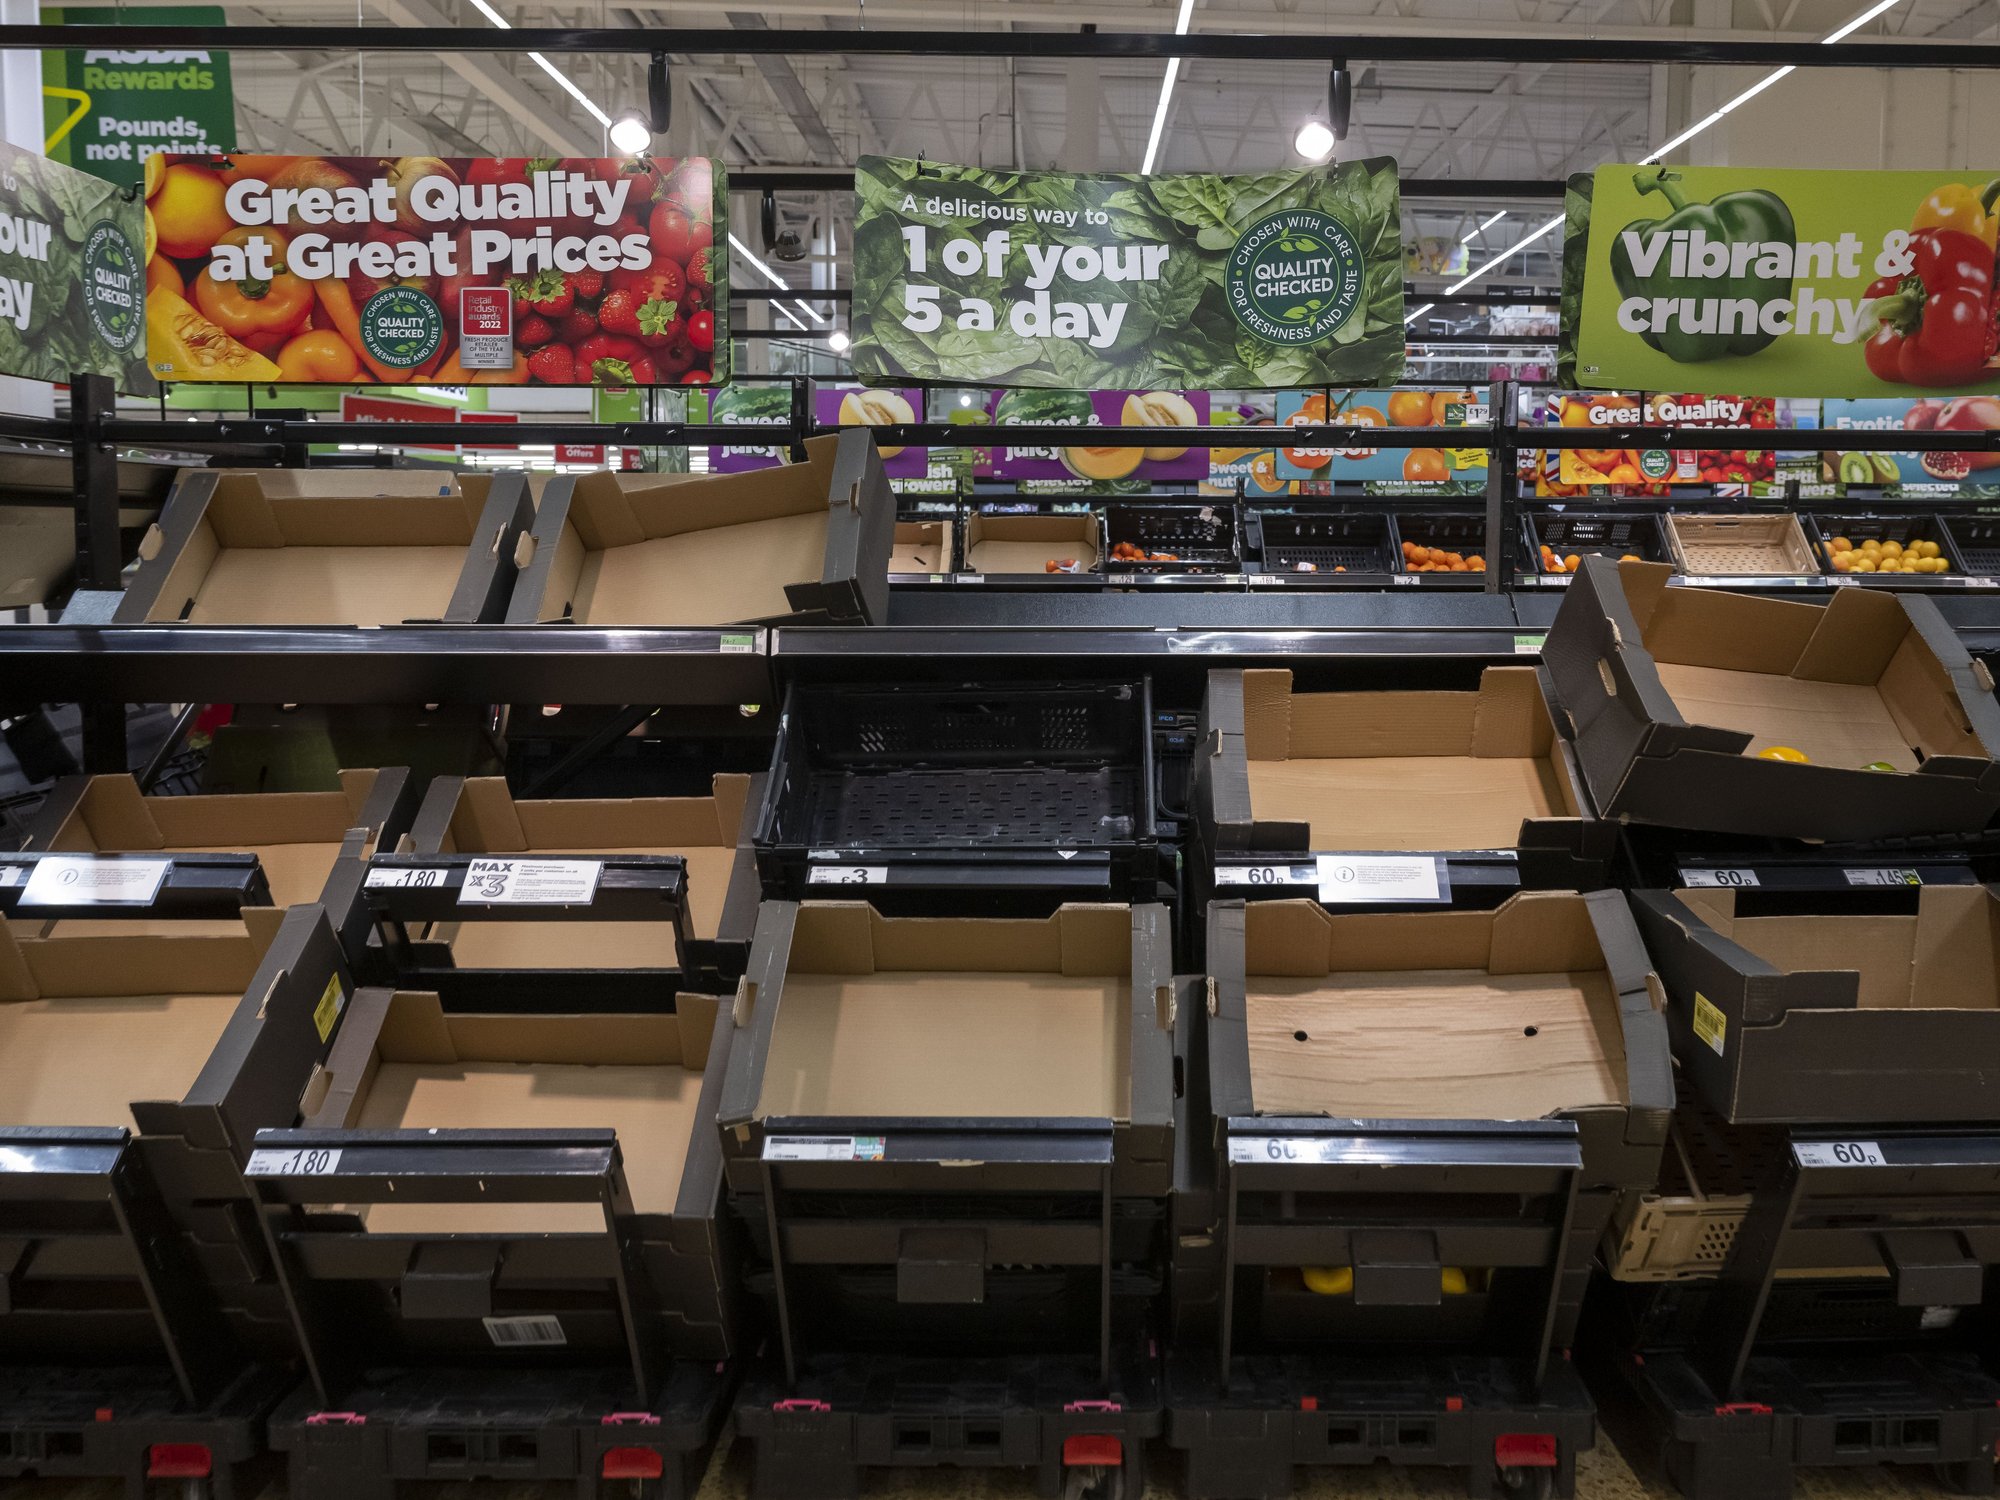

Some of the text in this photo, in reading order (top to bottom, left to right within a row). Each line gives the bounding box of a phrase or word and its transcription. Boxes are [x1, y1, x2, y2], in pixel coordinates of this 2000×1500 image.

[84, 66, 214, 90] Rewards
[98, 116, 207, 140] Pounds,
[86, 140, 222, 164] not points
[225, 171, 632, 227] Great Quality
[901, 195, 1108, 228] A delicious way to
[1237, 216, 1352, 266] CHOSEN WITH CARE
[209, 227, 652, 282] at Great Prices
[902, 227, 1169, 290] 1 of your
[1622, 230, 1916, 279] Vibrant &
[95, 267, 131, 290] QUALITY
[1254, 258, 1334, 280] QUALITY
[96, 286, 132, 308] CHECKED
[1255, 278, 1334, 297] CHECKED
[367, 291, 436, 319] CHOSEN WITH CARE
[468, 296, 492, 304] Retail
[1232, 270, 1358, 340] FOR FRESHNESS AND TASTE
[378, 318, 424, 328] QUALITY
[480, 320, 501, 328] 2022
[902, 284, 1128, 348] 5 a day
[1616, 288, 1876, 344] crunchy
[364, 326, 438, 364] FOR FRESHNESS AND TASTE
[378, 329, 424, 338] CHECKED
[1590, 400, 1744, 424] Great Quality
[566, 450, 594, 458] Offers
[1210, 461, 1267, 474] Sweet &
[472, 863, 513, 872] MAX
[1248, 868, 1284, 884] 60p
[1714, 870, 1752, 886] 60p
[1833, 1144, 1876, 1165] 60p
